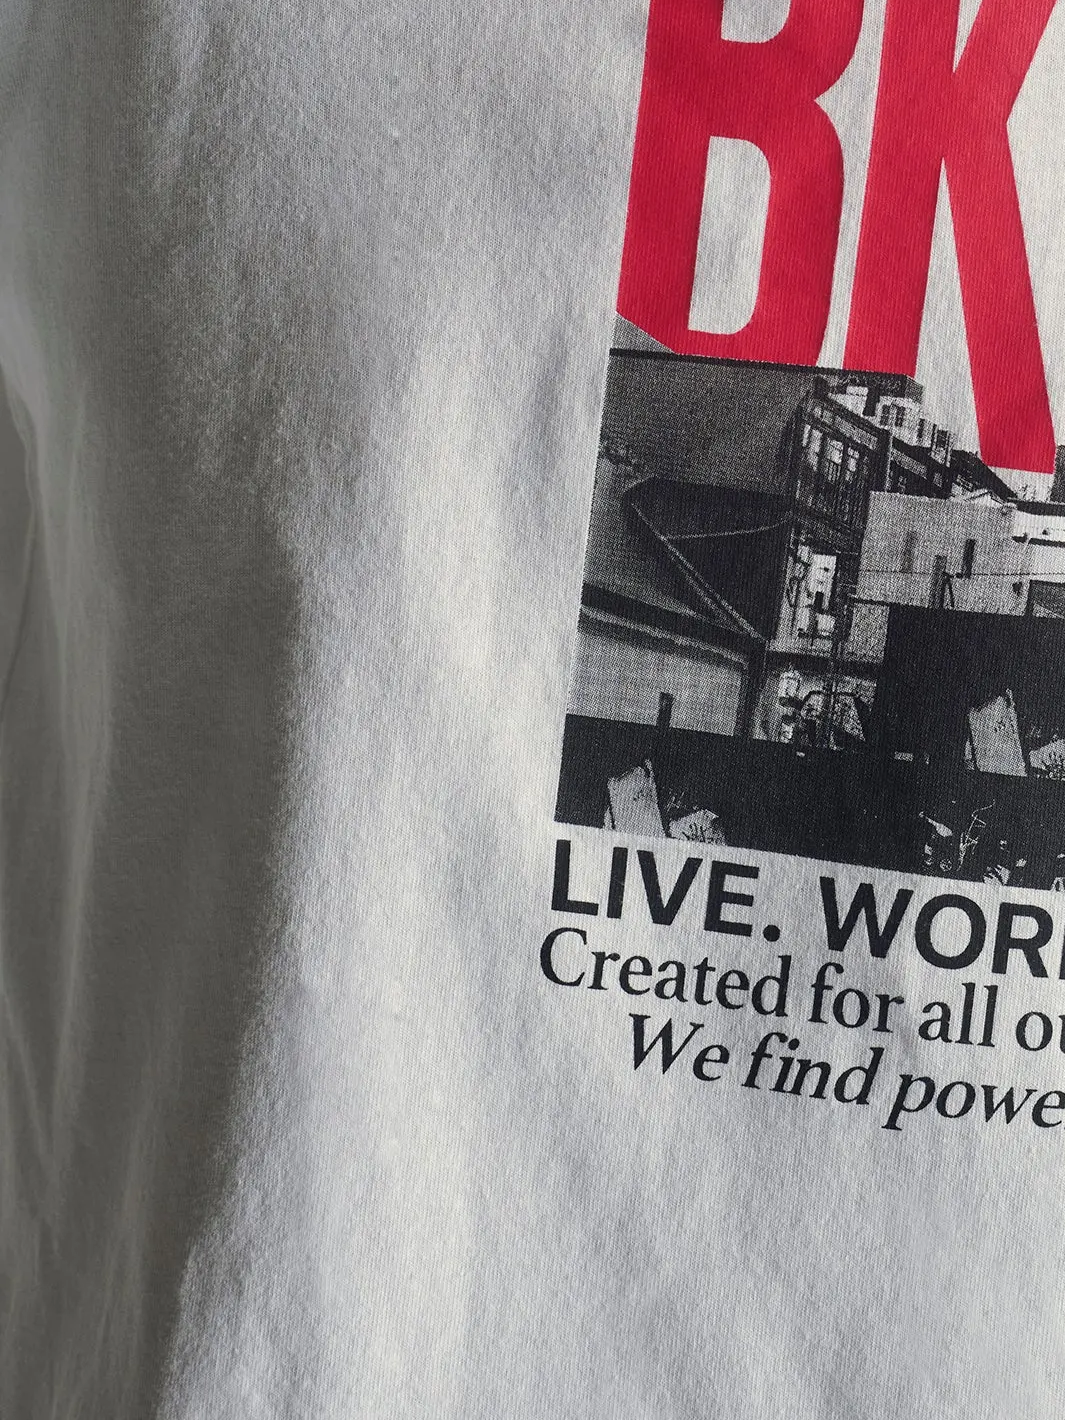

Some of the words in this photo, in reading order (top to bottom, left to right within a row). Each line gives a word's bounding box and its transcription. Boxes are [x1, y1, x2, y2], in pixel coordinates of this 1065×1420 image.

[550, 839, 781, 943] LIVE.
[539, 926, 792, 1018] Created
[807, 961, 905, 1034] for
[917, 981, 999, 1048] all
[628, 1012, 731, 1082] We
[740, 1030, 885, 1106] find
